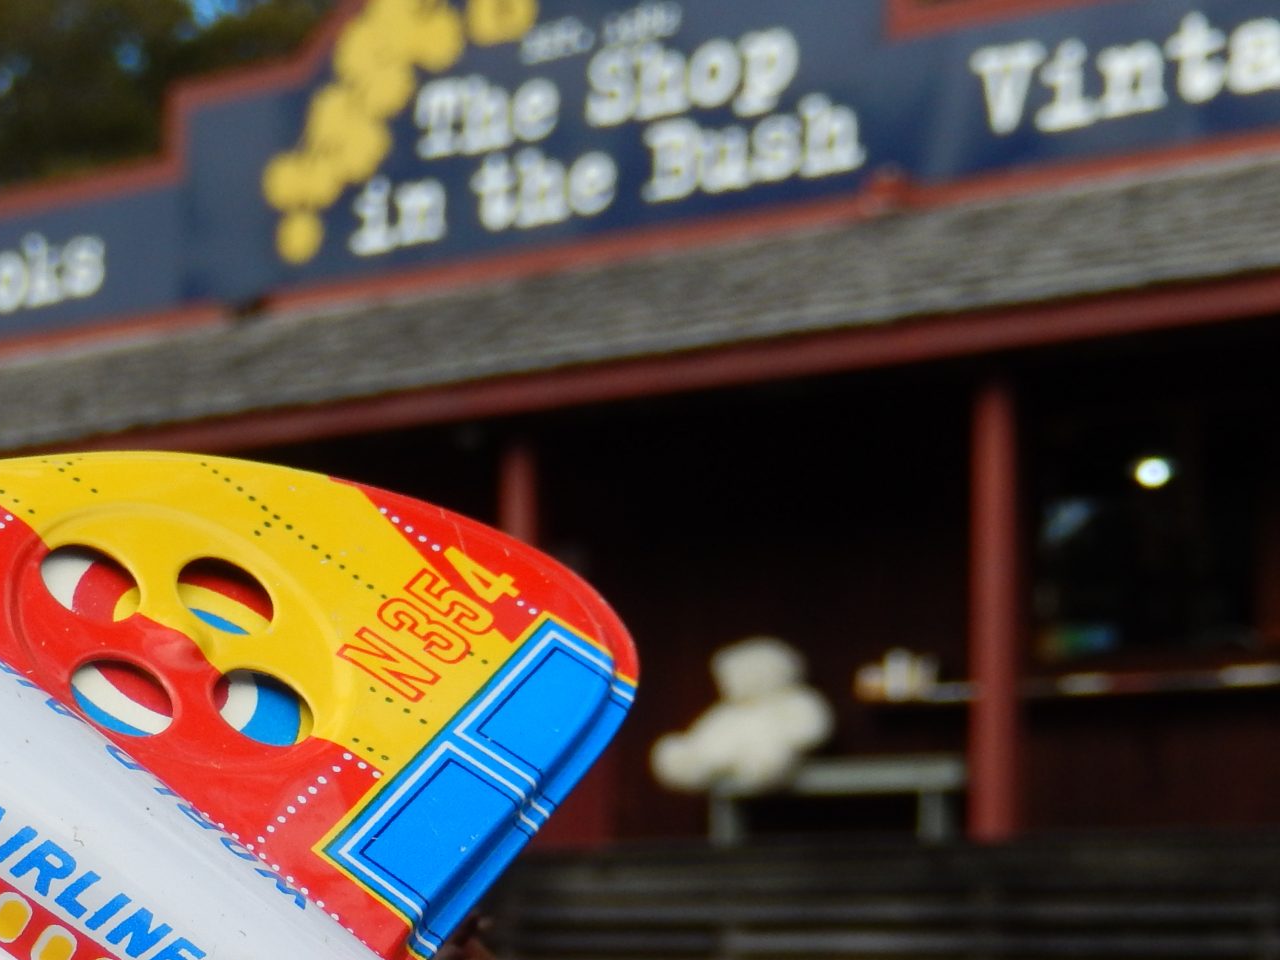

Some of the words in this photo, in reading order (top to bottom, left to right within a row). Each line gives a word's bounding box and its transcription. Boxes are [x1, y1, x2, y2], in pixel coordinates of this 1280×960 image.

[415, 76, 560, 160] The
[584, 26, 800, 128] Shop
[350, 176, 447, 256] in
[471, 149, 618, 232] the
[642, 94, 866, 203] Bush
[336, 546, 520, 702] N354
